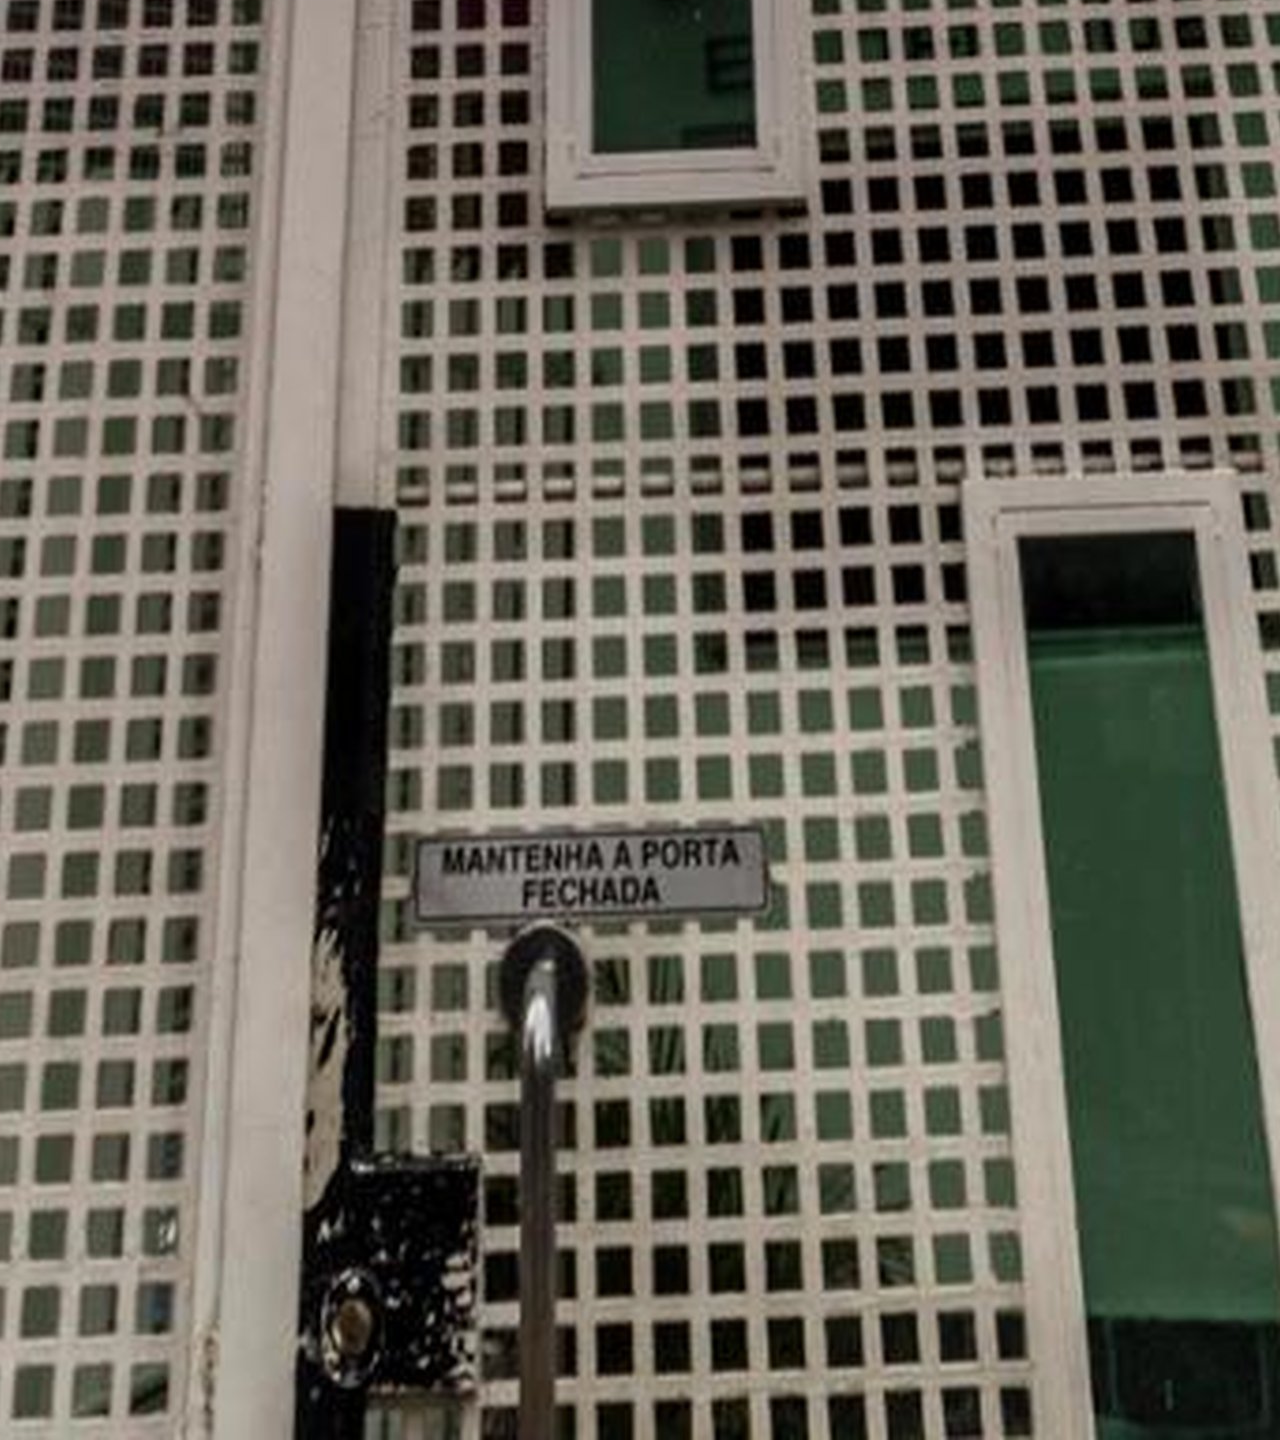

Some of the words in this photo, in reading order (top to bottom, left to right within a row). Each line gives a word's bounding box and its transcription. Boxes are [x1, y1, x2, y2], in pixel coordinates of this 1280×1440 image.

[441, 839, 604, 876] MANTENHA
[612, 841, 633, 871] A
[640, 836, 741, 870] PORTA
[522, 875, 661, 909] FECHADA
